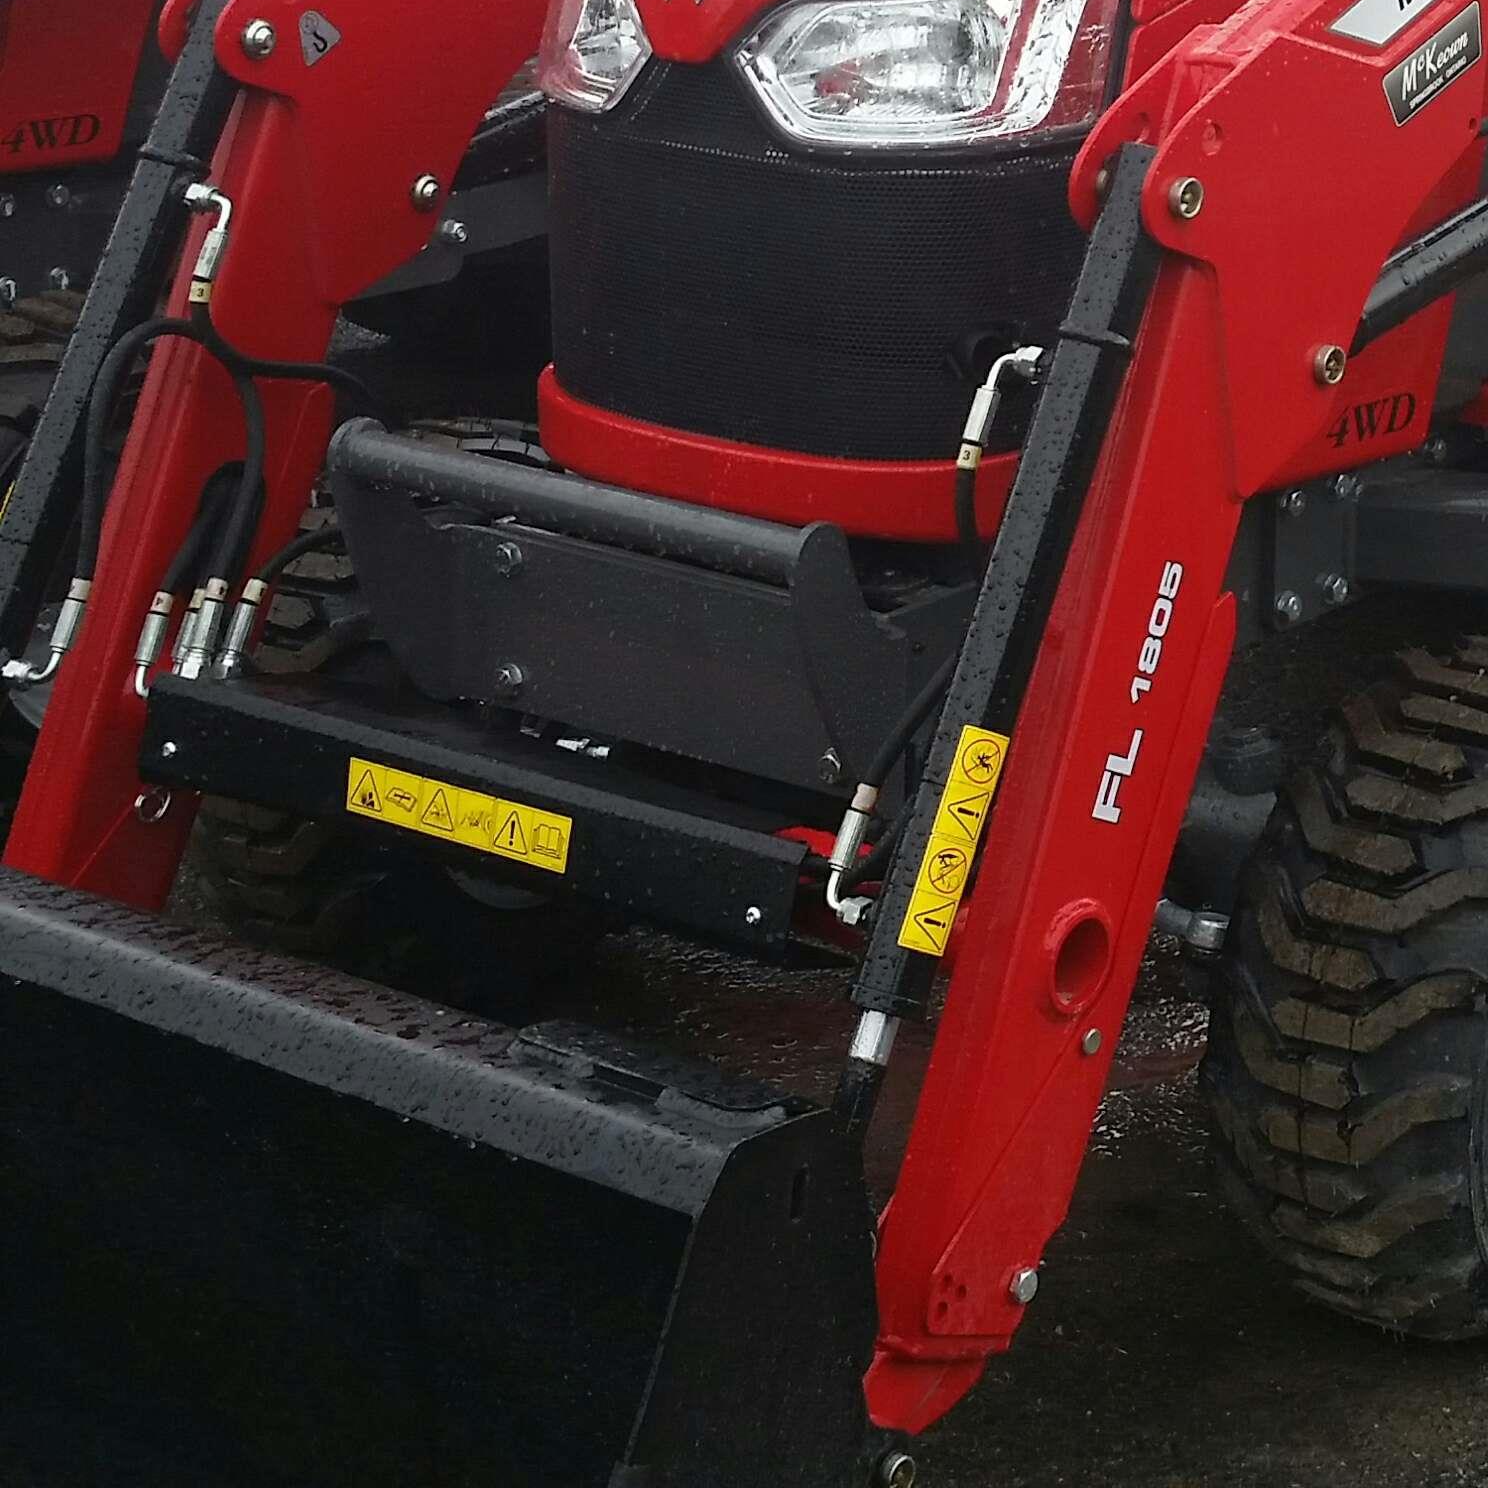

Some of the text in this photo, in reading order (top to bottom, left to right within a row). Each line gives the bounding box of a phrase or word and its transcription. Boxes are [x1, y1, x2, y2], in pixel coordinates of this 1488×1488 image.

[0, 114, 101, 153] 4WD
[1326, 392, 1417, 449] 4WD
[962, 449, 971, 461] 3
[1091, 560, 1184, 824] FL 1805
